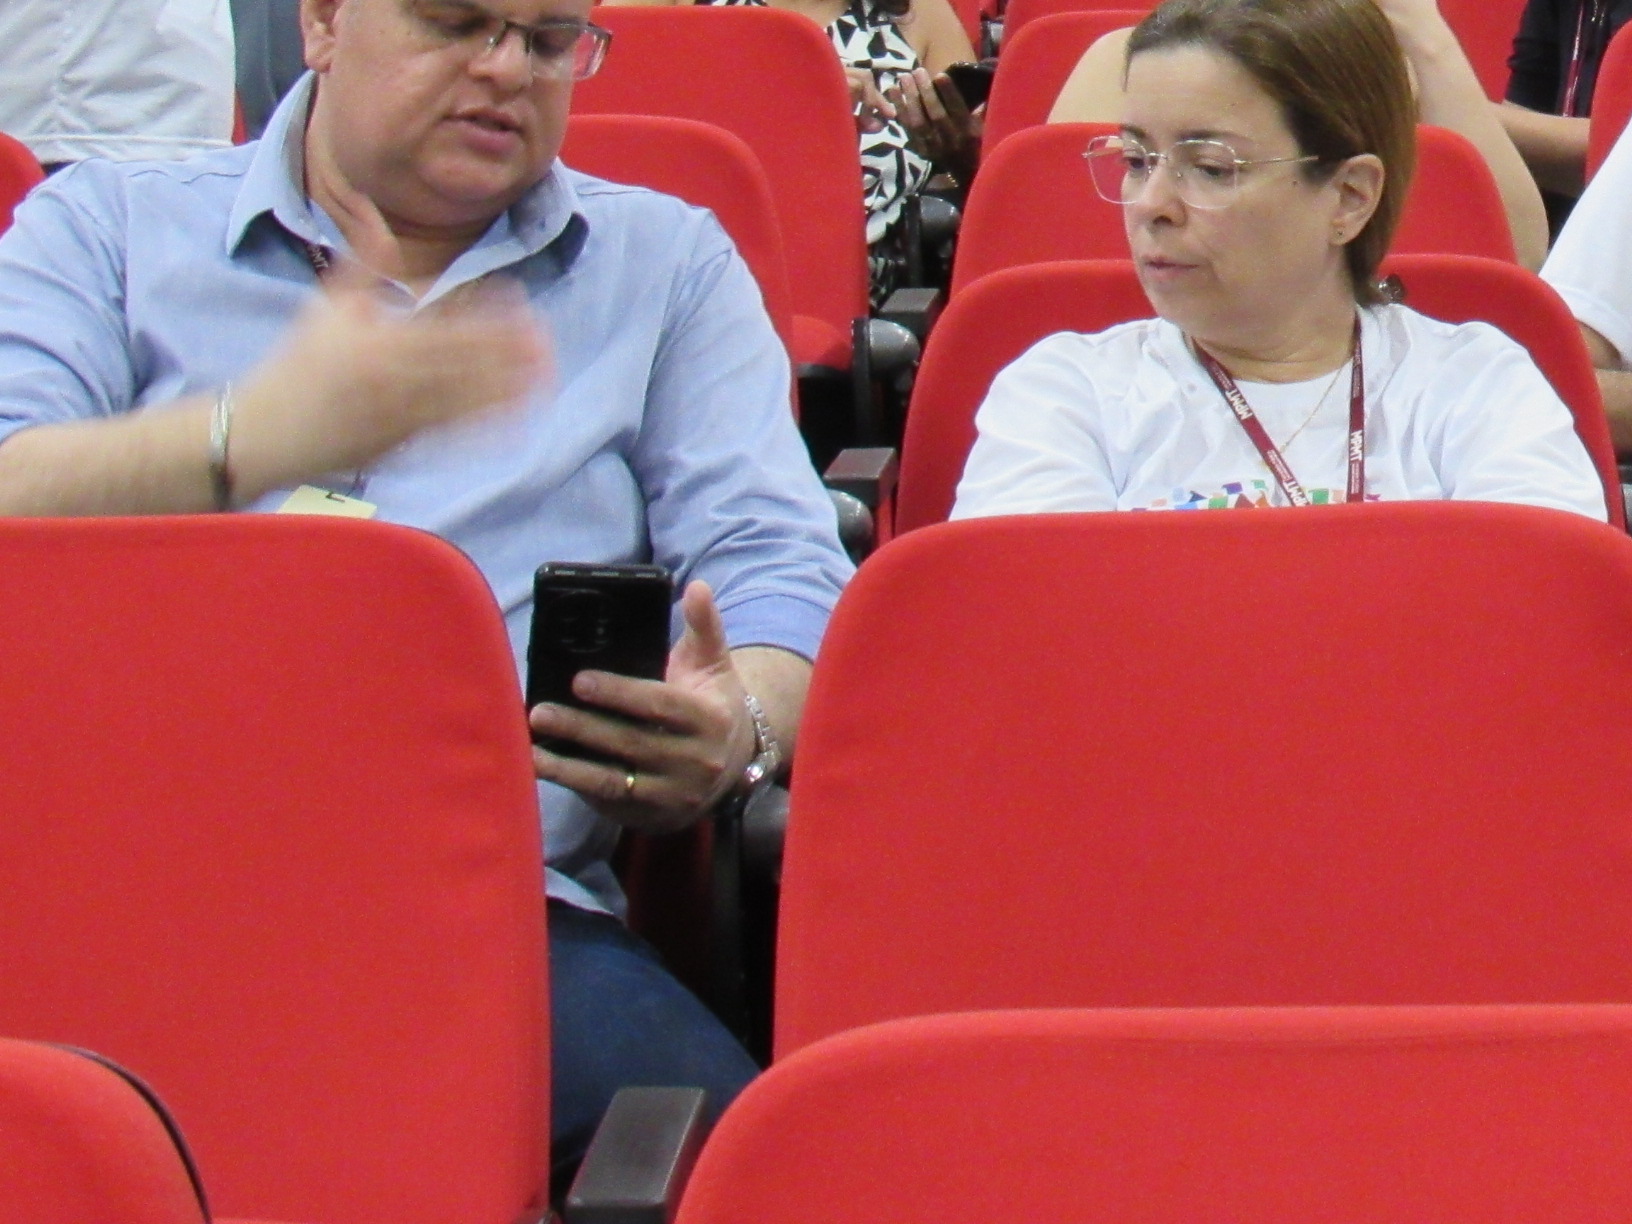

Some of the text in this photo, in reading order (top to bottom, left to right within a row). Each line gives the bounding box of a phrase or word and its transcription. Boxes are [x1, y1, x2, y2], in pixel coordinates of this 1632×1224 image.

[1225, 387, 1254, 420] MPMT
[1350, 430, 1363, 461] MPMT
[1282, 480, 1309, 507] PMT
